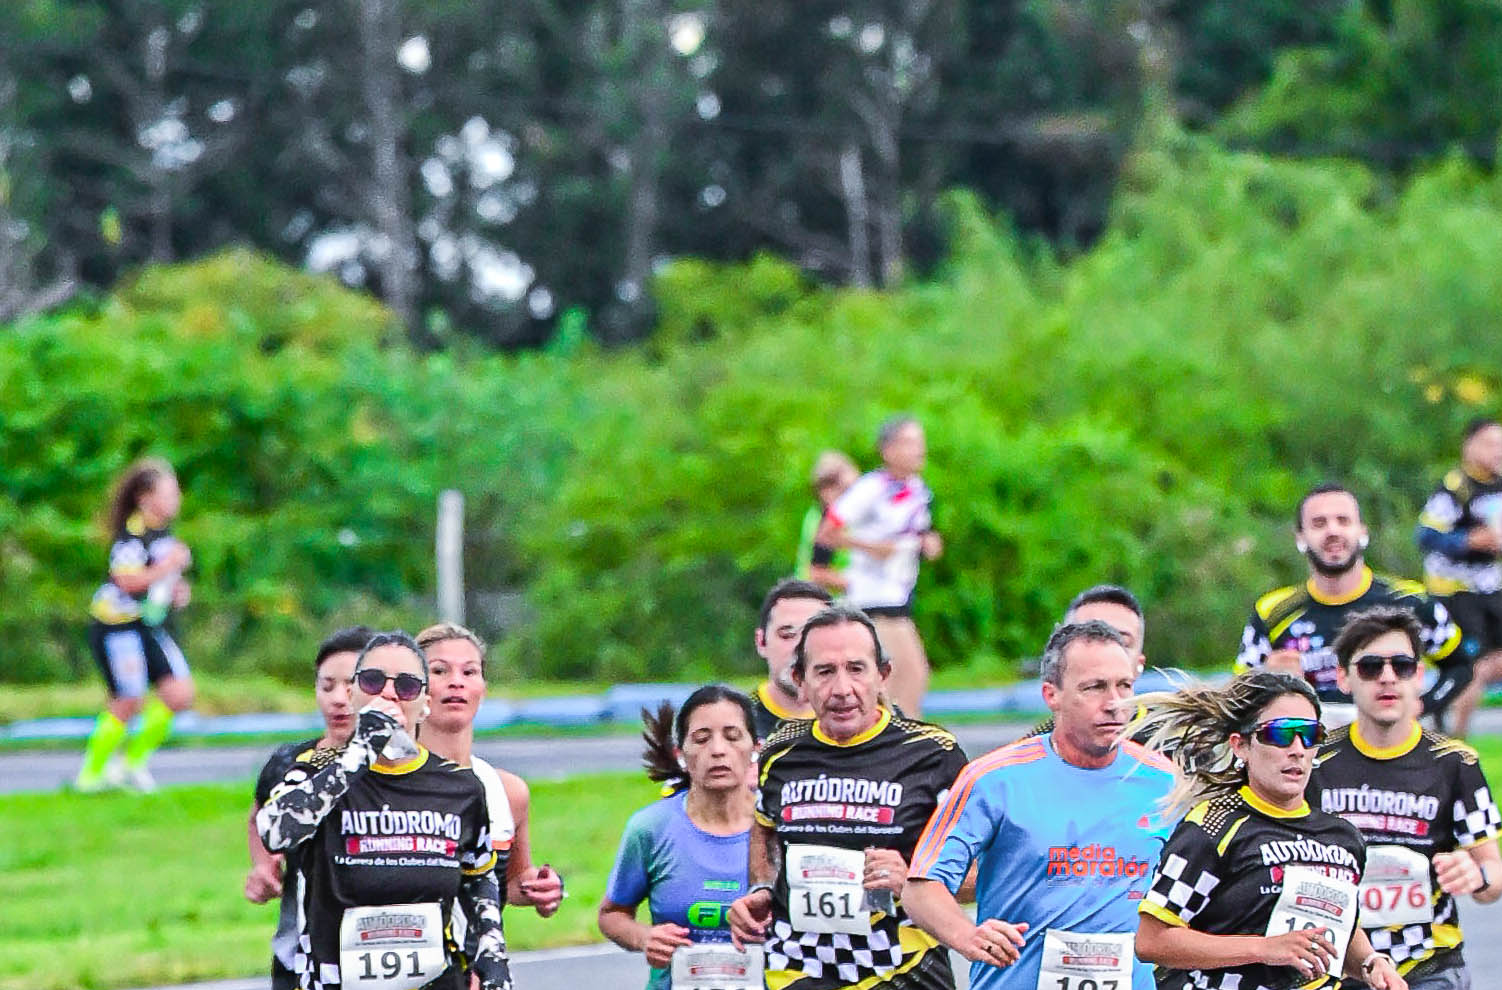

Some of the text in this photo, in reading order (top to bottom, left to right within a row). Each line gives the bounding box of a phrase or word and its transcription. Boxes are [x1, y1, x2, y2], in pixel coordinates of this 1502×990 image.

[780, 773, 903, 807] AUTÓDROMO
[1321, 783, 1440, 821] AUTÓDROMO
[341, 803, 462, 840] AUTÓDROMO
[1048, 843, 1115, 860] media
[1260, 833, 1361, 875] AUTÓDROM
[802, 891, 855, 919] 161
[1359, 880, 1427, 911] 076
[359, 951, 425, 980] 191
